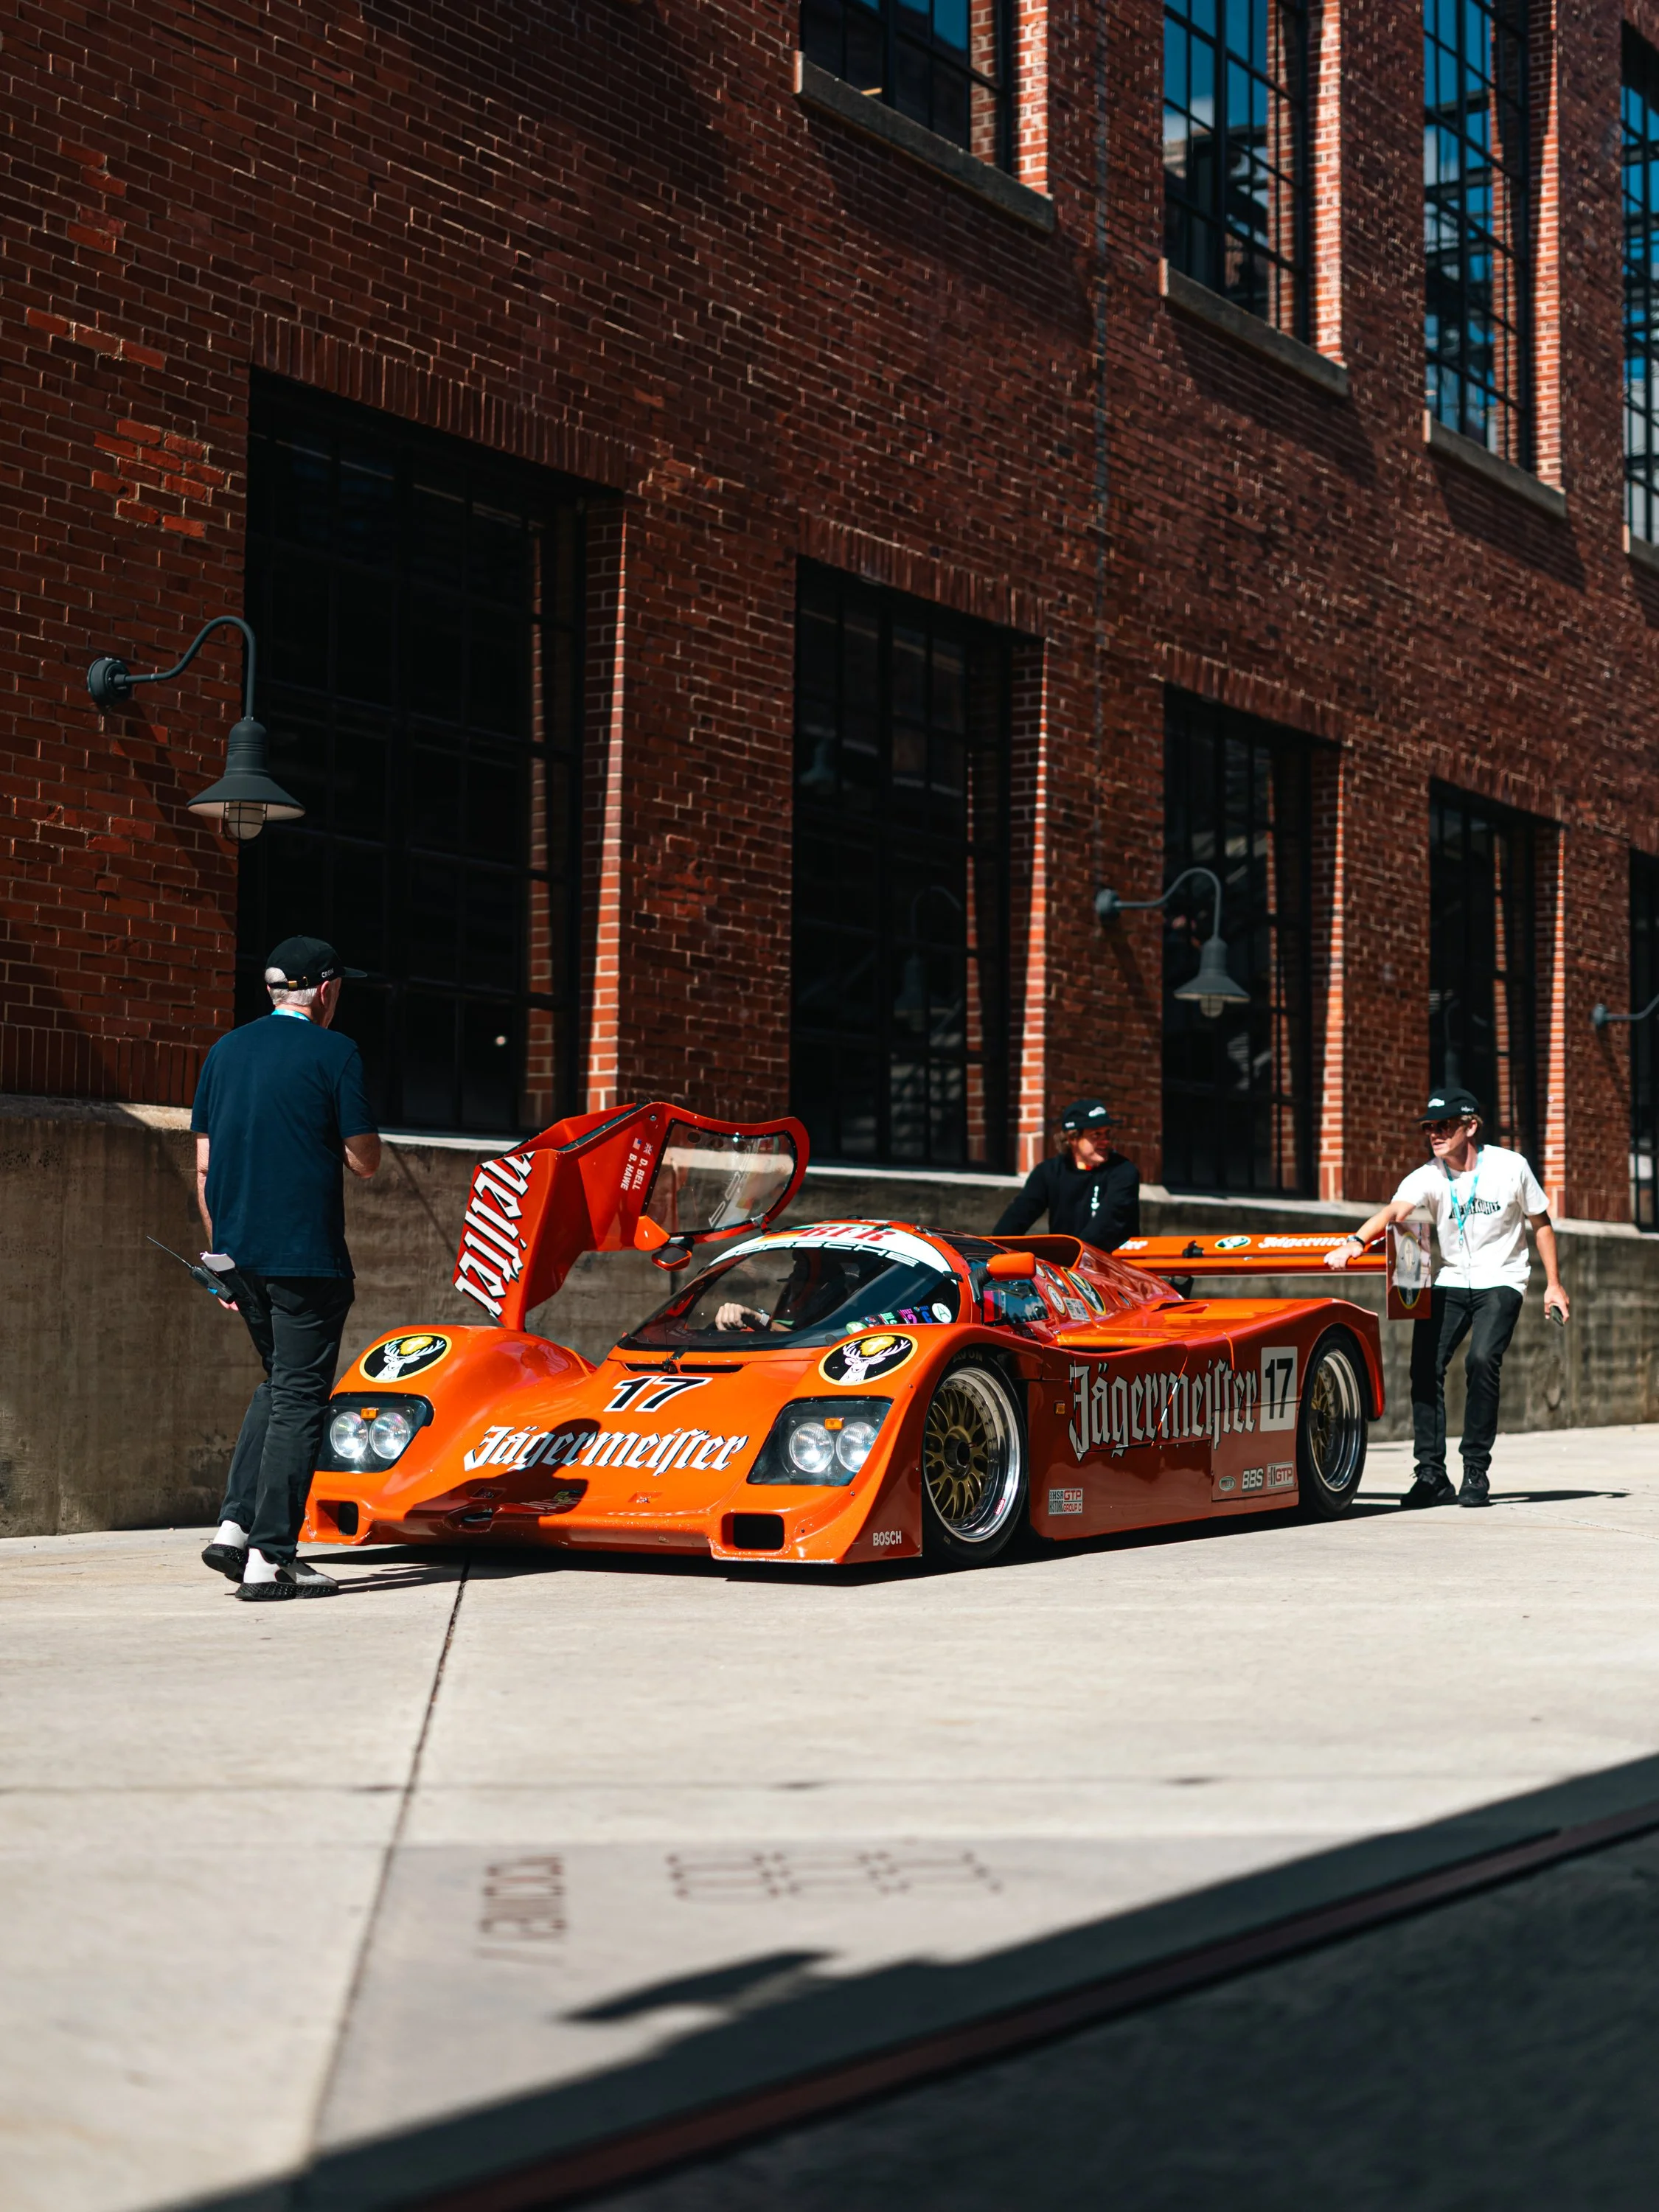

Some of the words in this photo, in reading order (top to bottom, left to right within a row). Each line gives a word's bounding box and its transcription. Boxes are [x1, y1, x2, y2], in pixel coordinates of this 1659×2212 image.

[321, 968, 335, 978] CREW
[628, 1152, 638, 1162] B.
[639, 1158, 648, 1166] D.
[620, 1164, 634, 1191] HAWE
[632, 1168, 645, 1189] BELL
[937, 1306, 950, 1320] A
[603, 1376, 713, 1412] 17
[1265, 1357, 1293, 1420] 17
[1242, 1467, 1264, 1490] BBS
[1276, 1467, 1293, 1483] GTP
[1064, 1489, 1082, 1500] GTP
[873, 1531, 902, 1546] BOSCH
